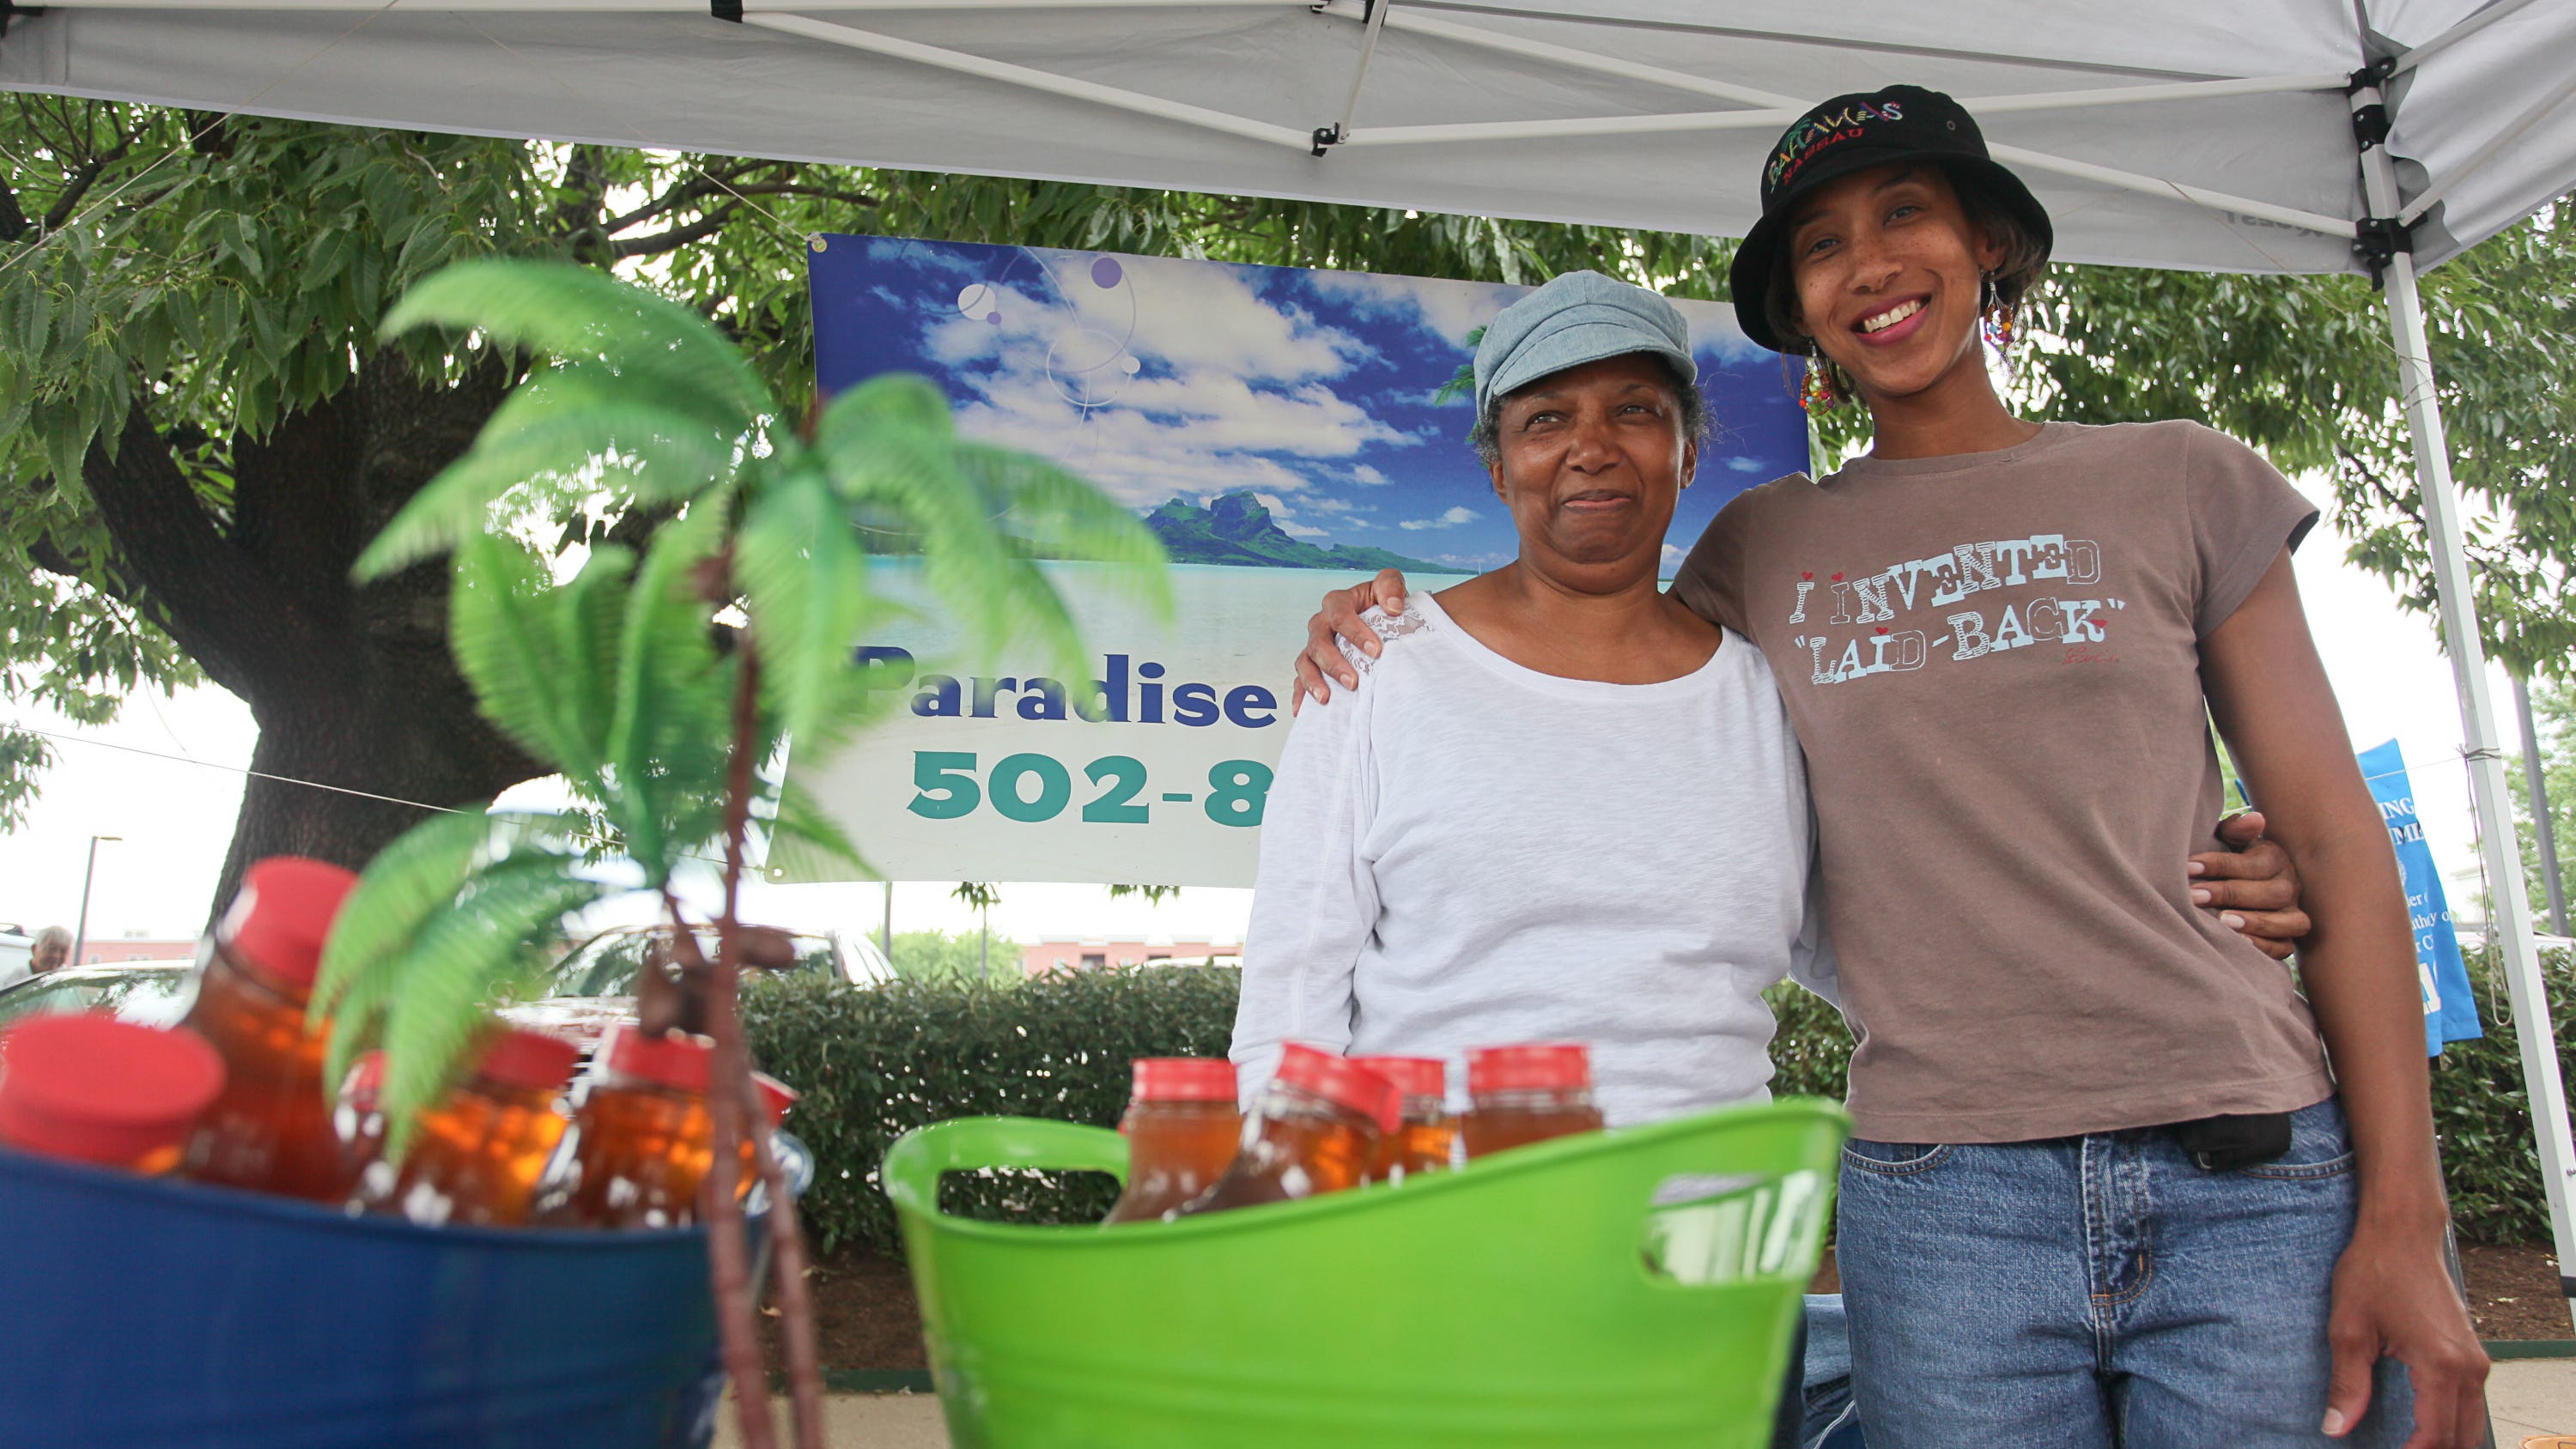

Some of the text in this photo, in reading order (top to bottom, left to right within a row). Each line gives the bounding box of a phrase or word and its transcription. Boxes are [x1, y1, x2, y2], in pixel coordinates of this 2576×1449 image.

[1789, 533, 2102, 626] I INVENTED
[841, 646, 1278, 729] Paradise
